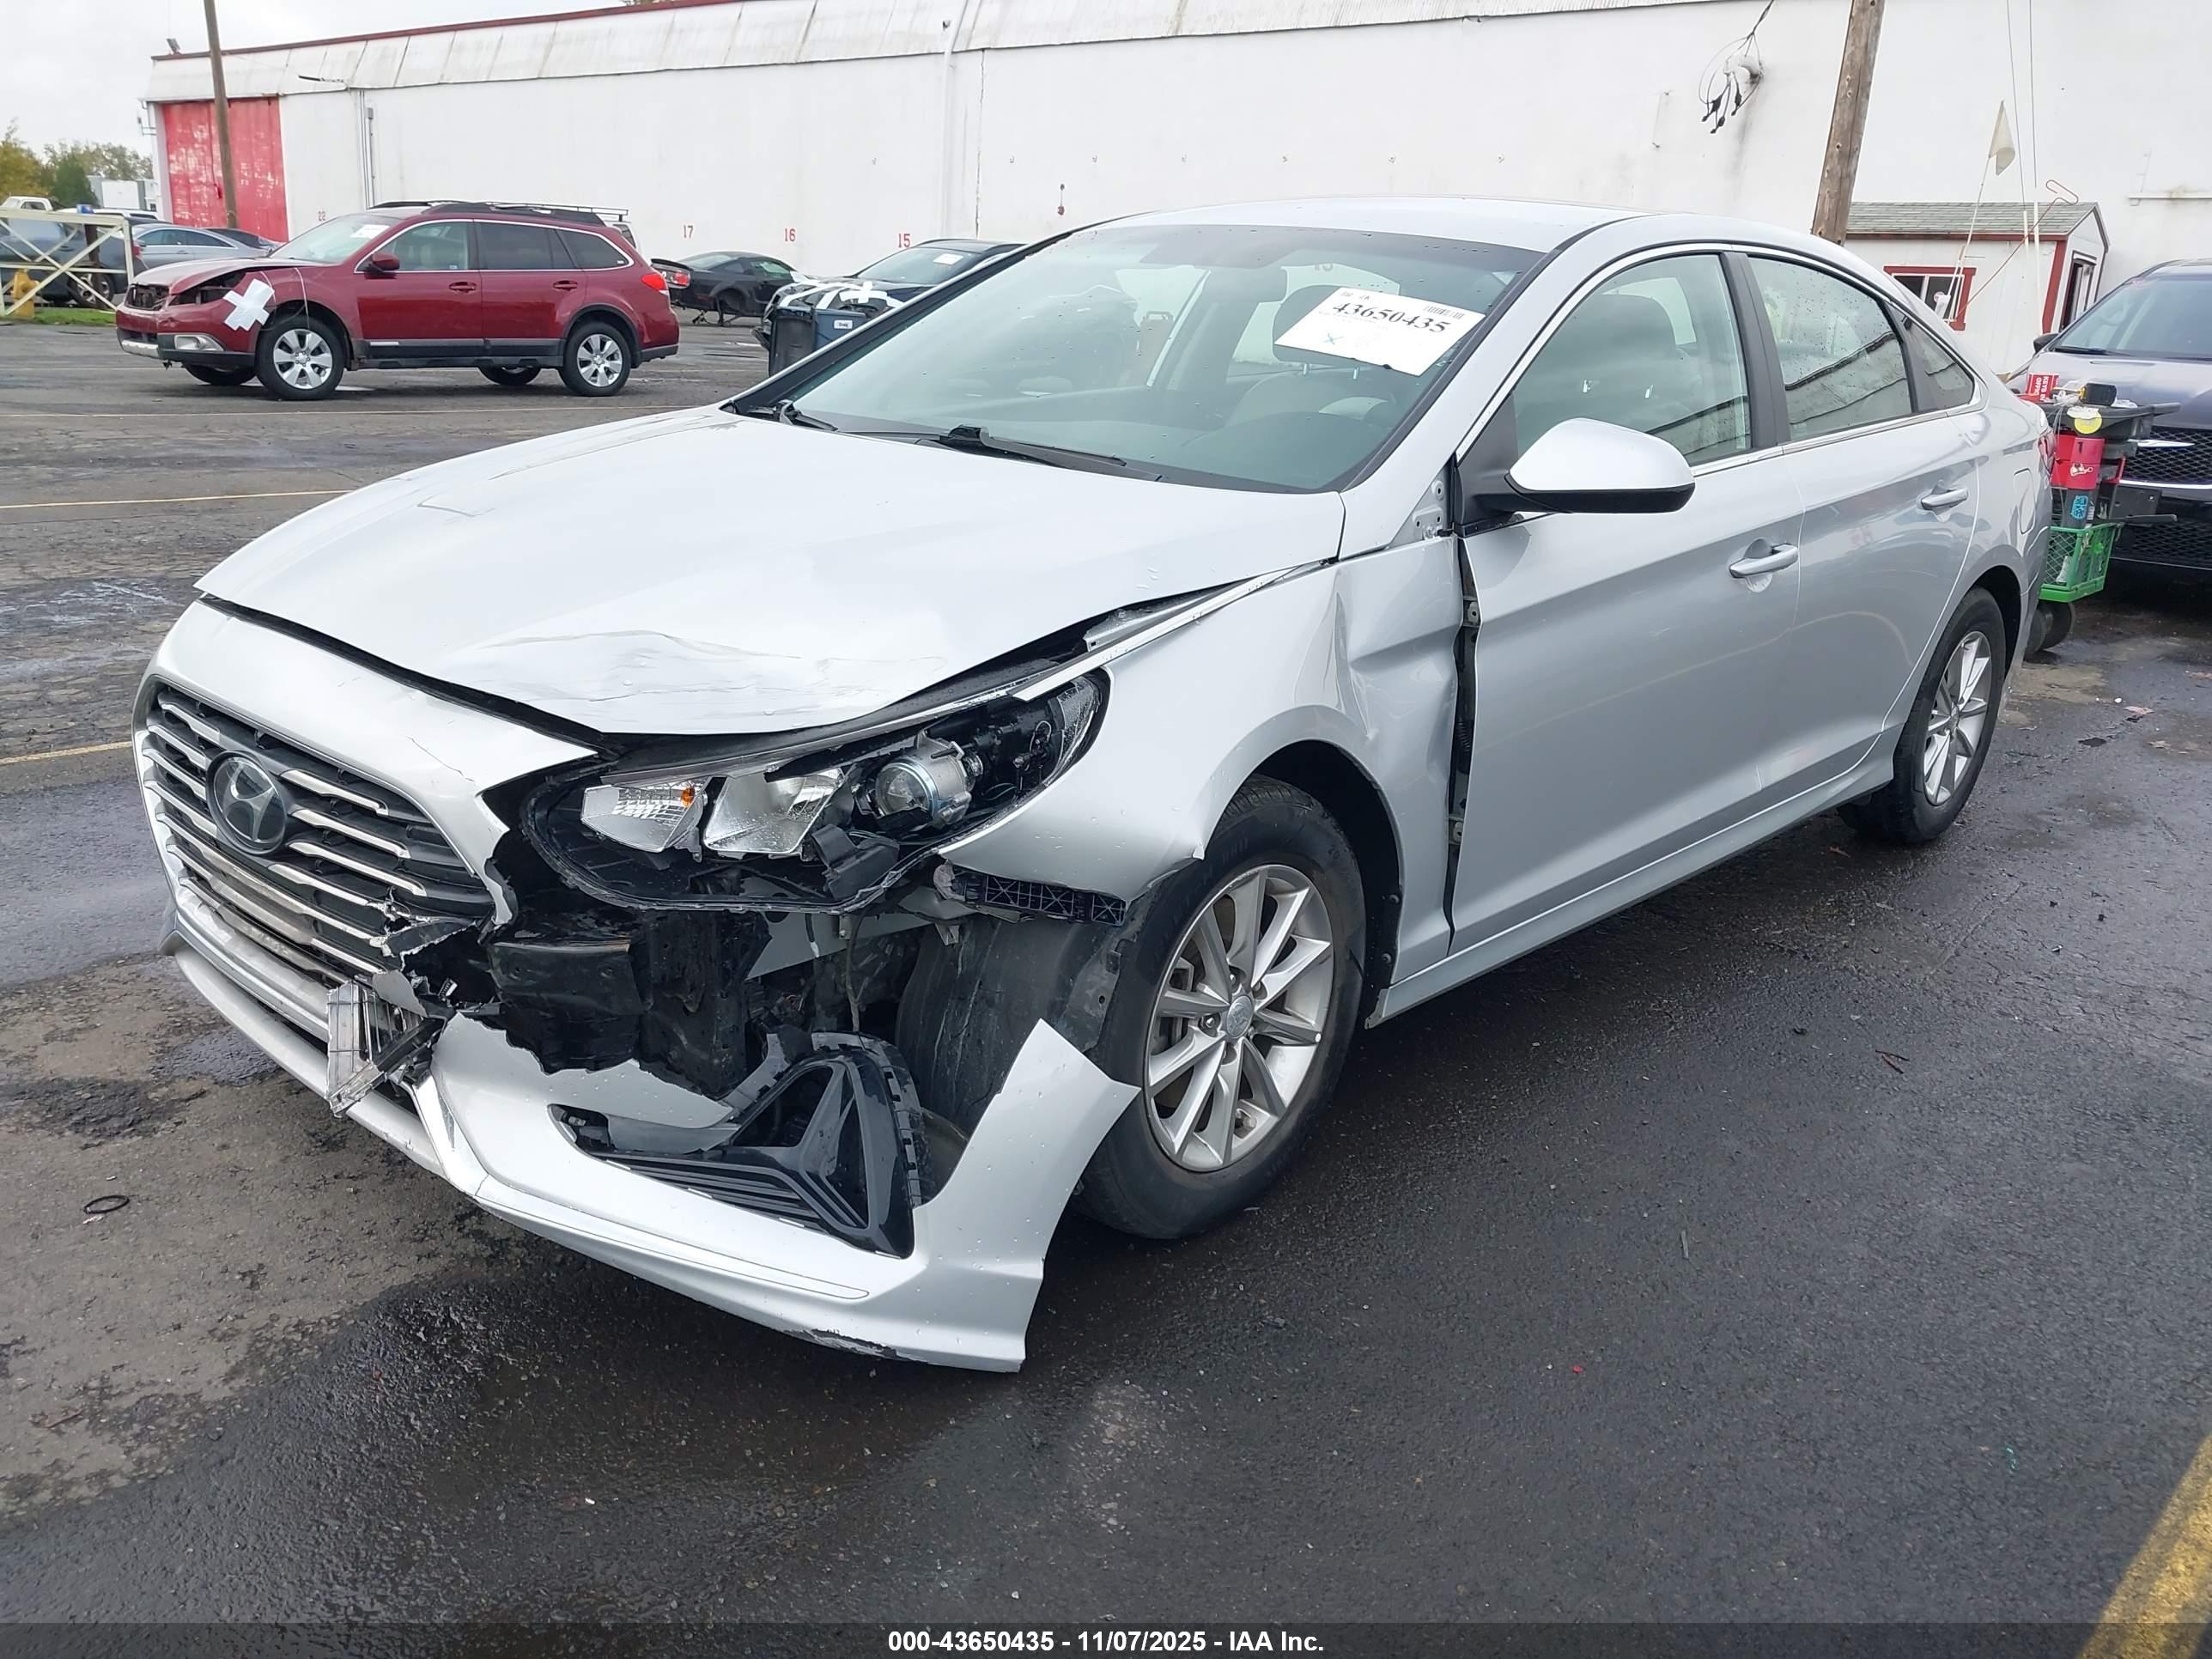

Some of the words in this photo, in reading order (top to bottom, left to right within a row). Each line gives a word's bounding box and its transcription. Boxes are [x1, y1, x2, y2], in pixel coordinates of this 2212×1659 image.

[683, 224, 694, 239] 17
[784, 228, 796, 242] 16
[897, 233, 911, 248] 15
[1333, 302, 1451, 333] 43650435
